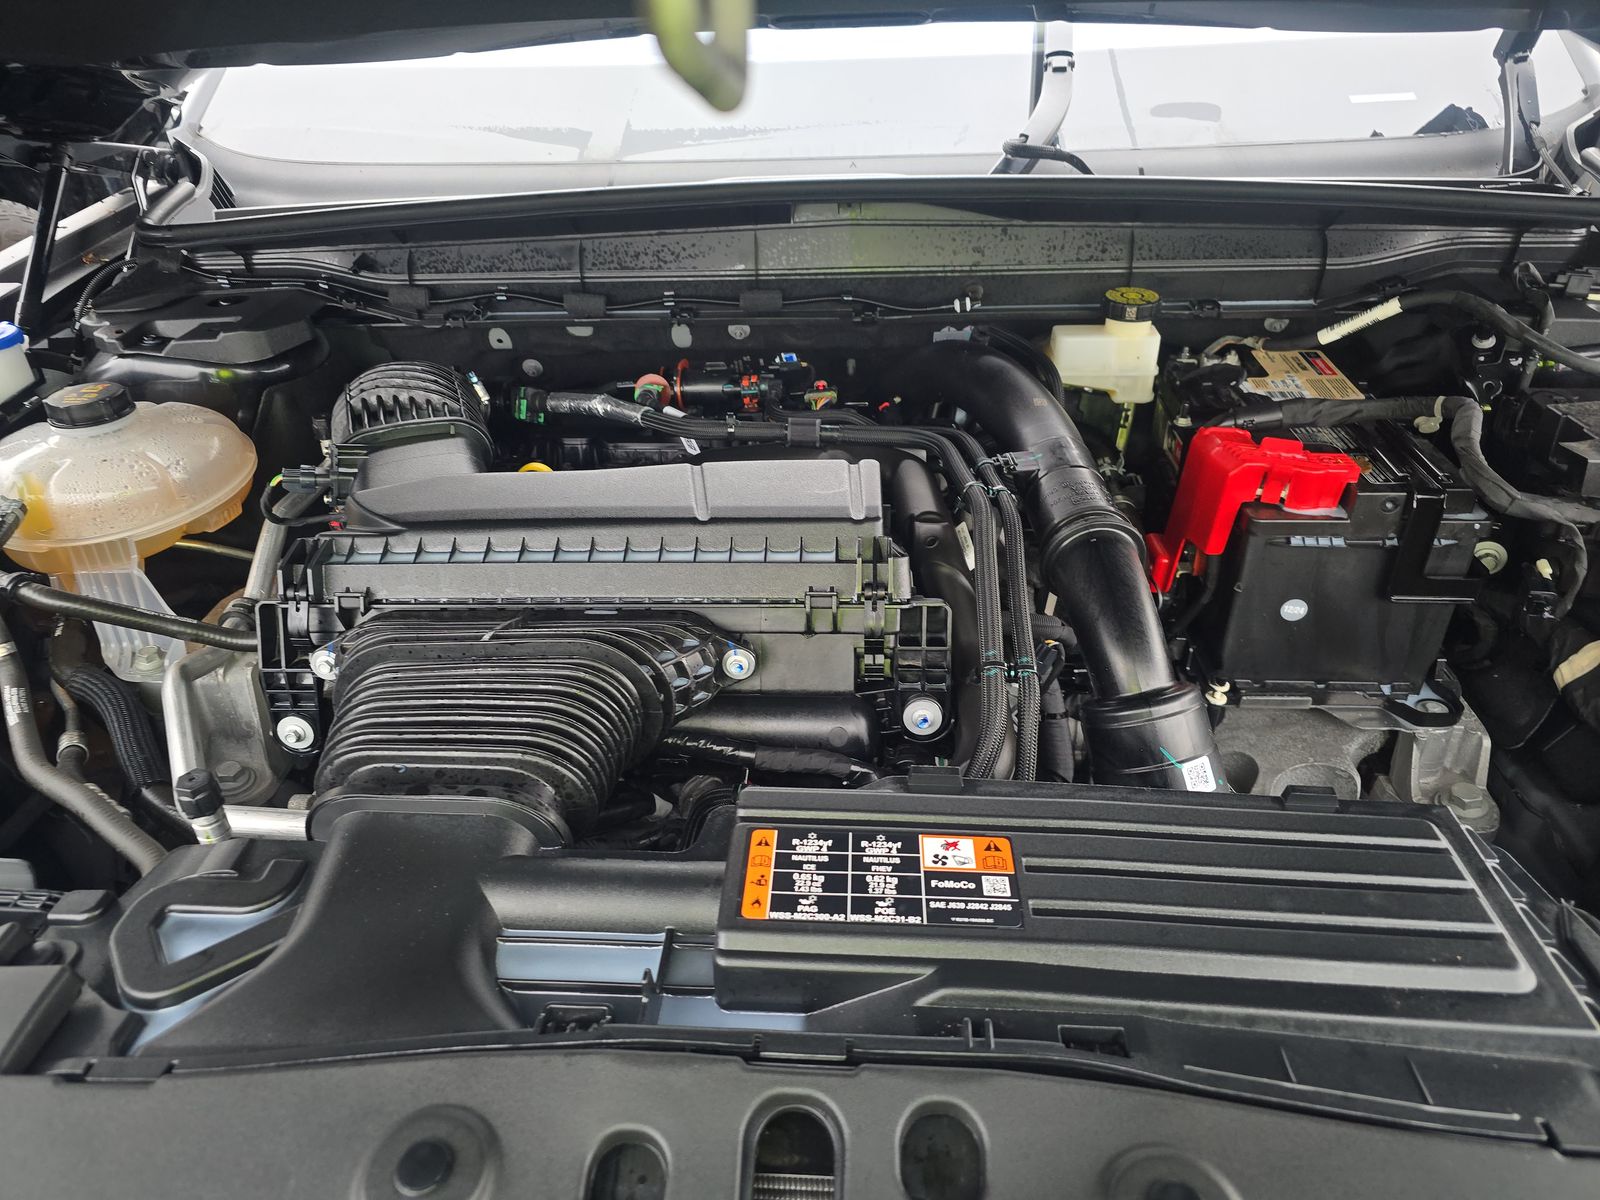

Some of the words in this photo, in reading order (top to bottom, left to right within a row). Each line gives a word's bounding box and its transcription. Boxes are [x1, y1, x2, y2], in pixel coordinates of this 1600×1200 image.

[861, 841, 902, 849] R-1234yf
[813, 874, 824, 882] kg
[886, 876, 898, 884] kg
[931, 880, 976, 889] FoMoCo
